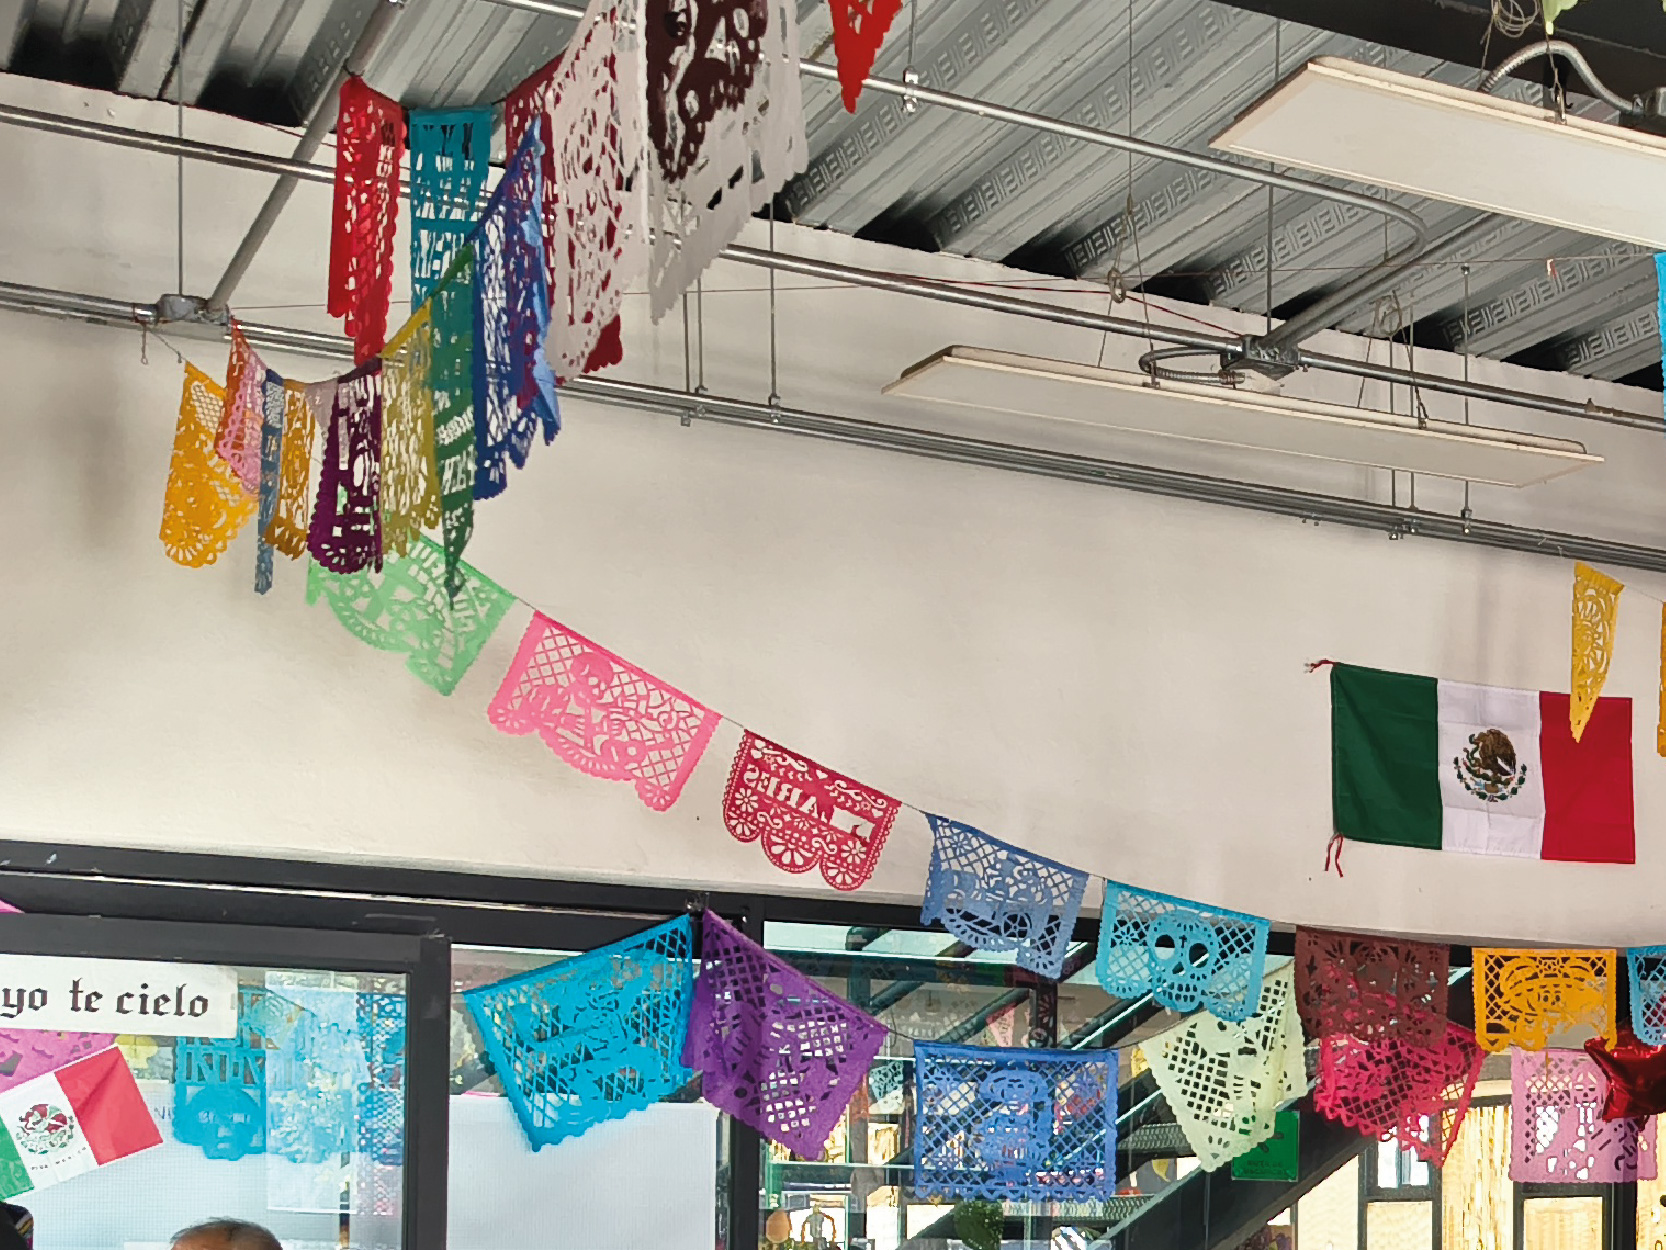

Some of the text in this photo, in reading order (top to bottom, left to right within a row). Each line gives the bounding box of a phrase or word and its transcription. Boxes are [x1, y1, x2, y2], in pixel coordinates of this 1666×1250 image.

[0, 977, 209, 1019] yo te cielo
